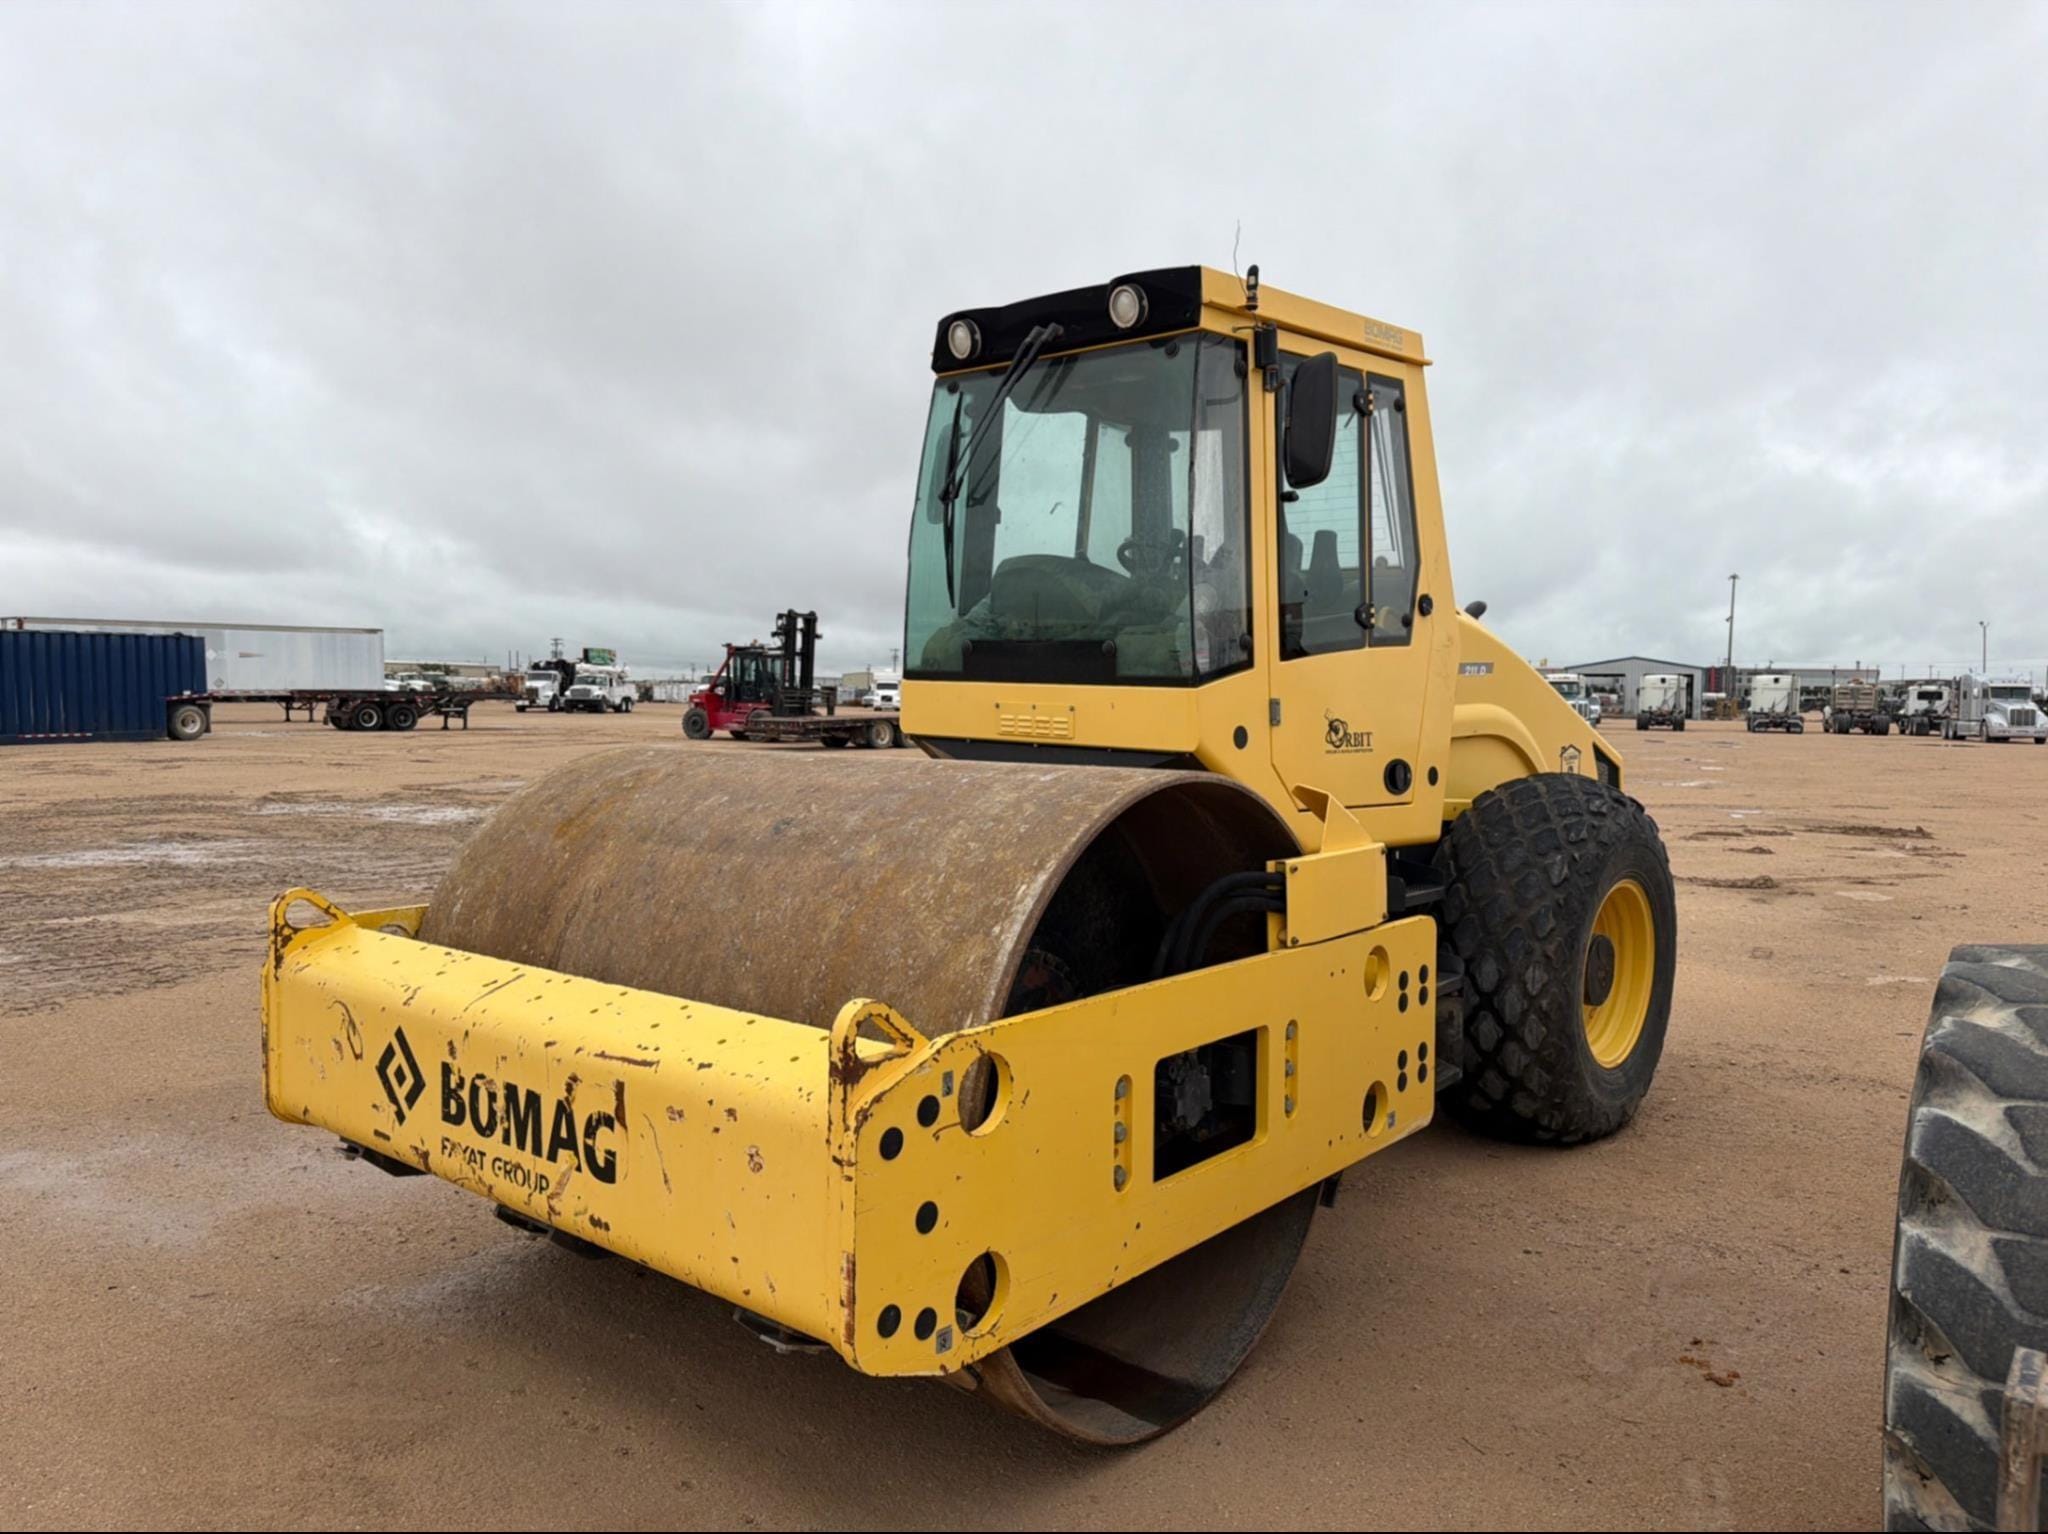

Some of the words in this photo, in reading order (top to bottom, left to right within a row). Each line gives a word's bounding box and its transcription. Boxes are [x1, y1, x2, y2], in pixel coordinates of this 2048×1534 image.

[1327, 718, 1373, 748] ORBIT
[441, 1061, 617, 1185] BOMAG
[492, 1156, 549, 1194] GROUP
